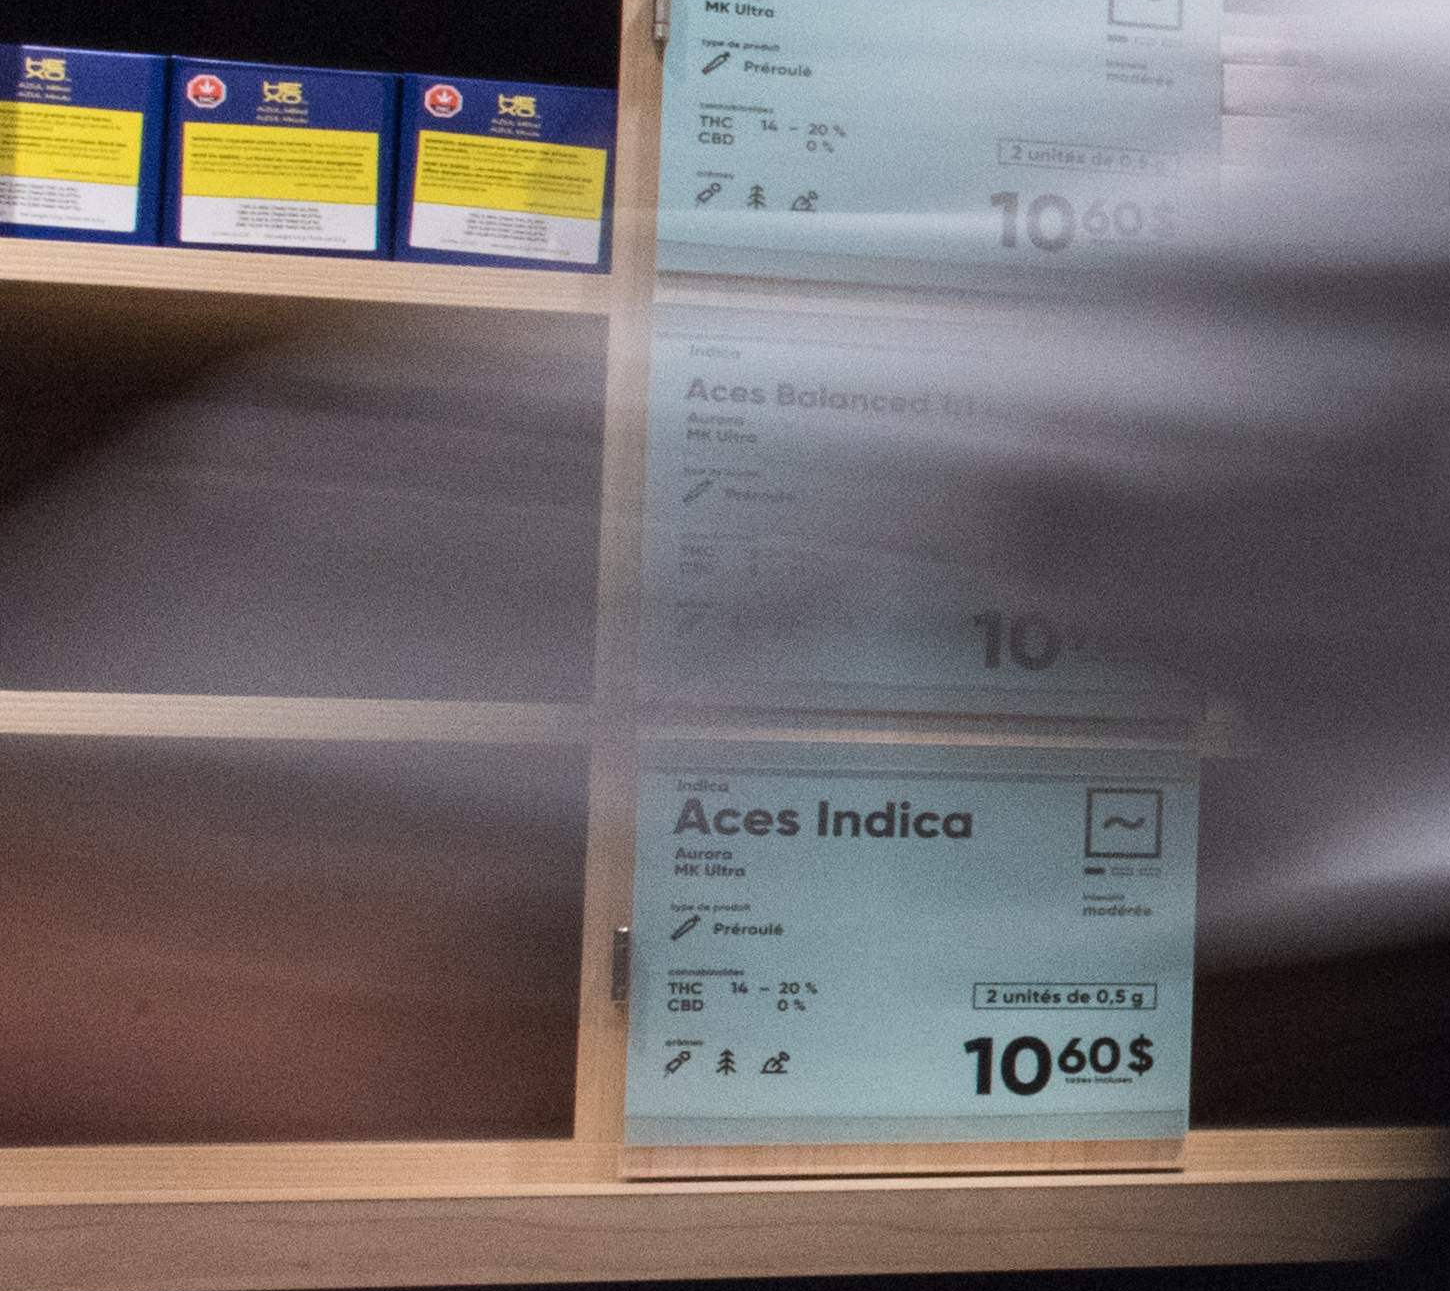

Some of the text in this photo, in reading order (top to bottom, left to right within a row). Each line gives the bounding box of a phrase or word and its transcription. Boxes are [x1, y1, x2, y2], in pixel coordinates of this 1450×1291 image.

[706, 0, 775, 19] MK Ultra
[676, 780, 729, 793] Indica
[674, 799, 973, 839] Aces Indica
[675, 847, 732, 860] Aurora
[675, 864, 746, 877] MK Ultra
[986, 988, 1144, 1008] 2 unités de 0,5 g
